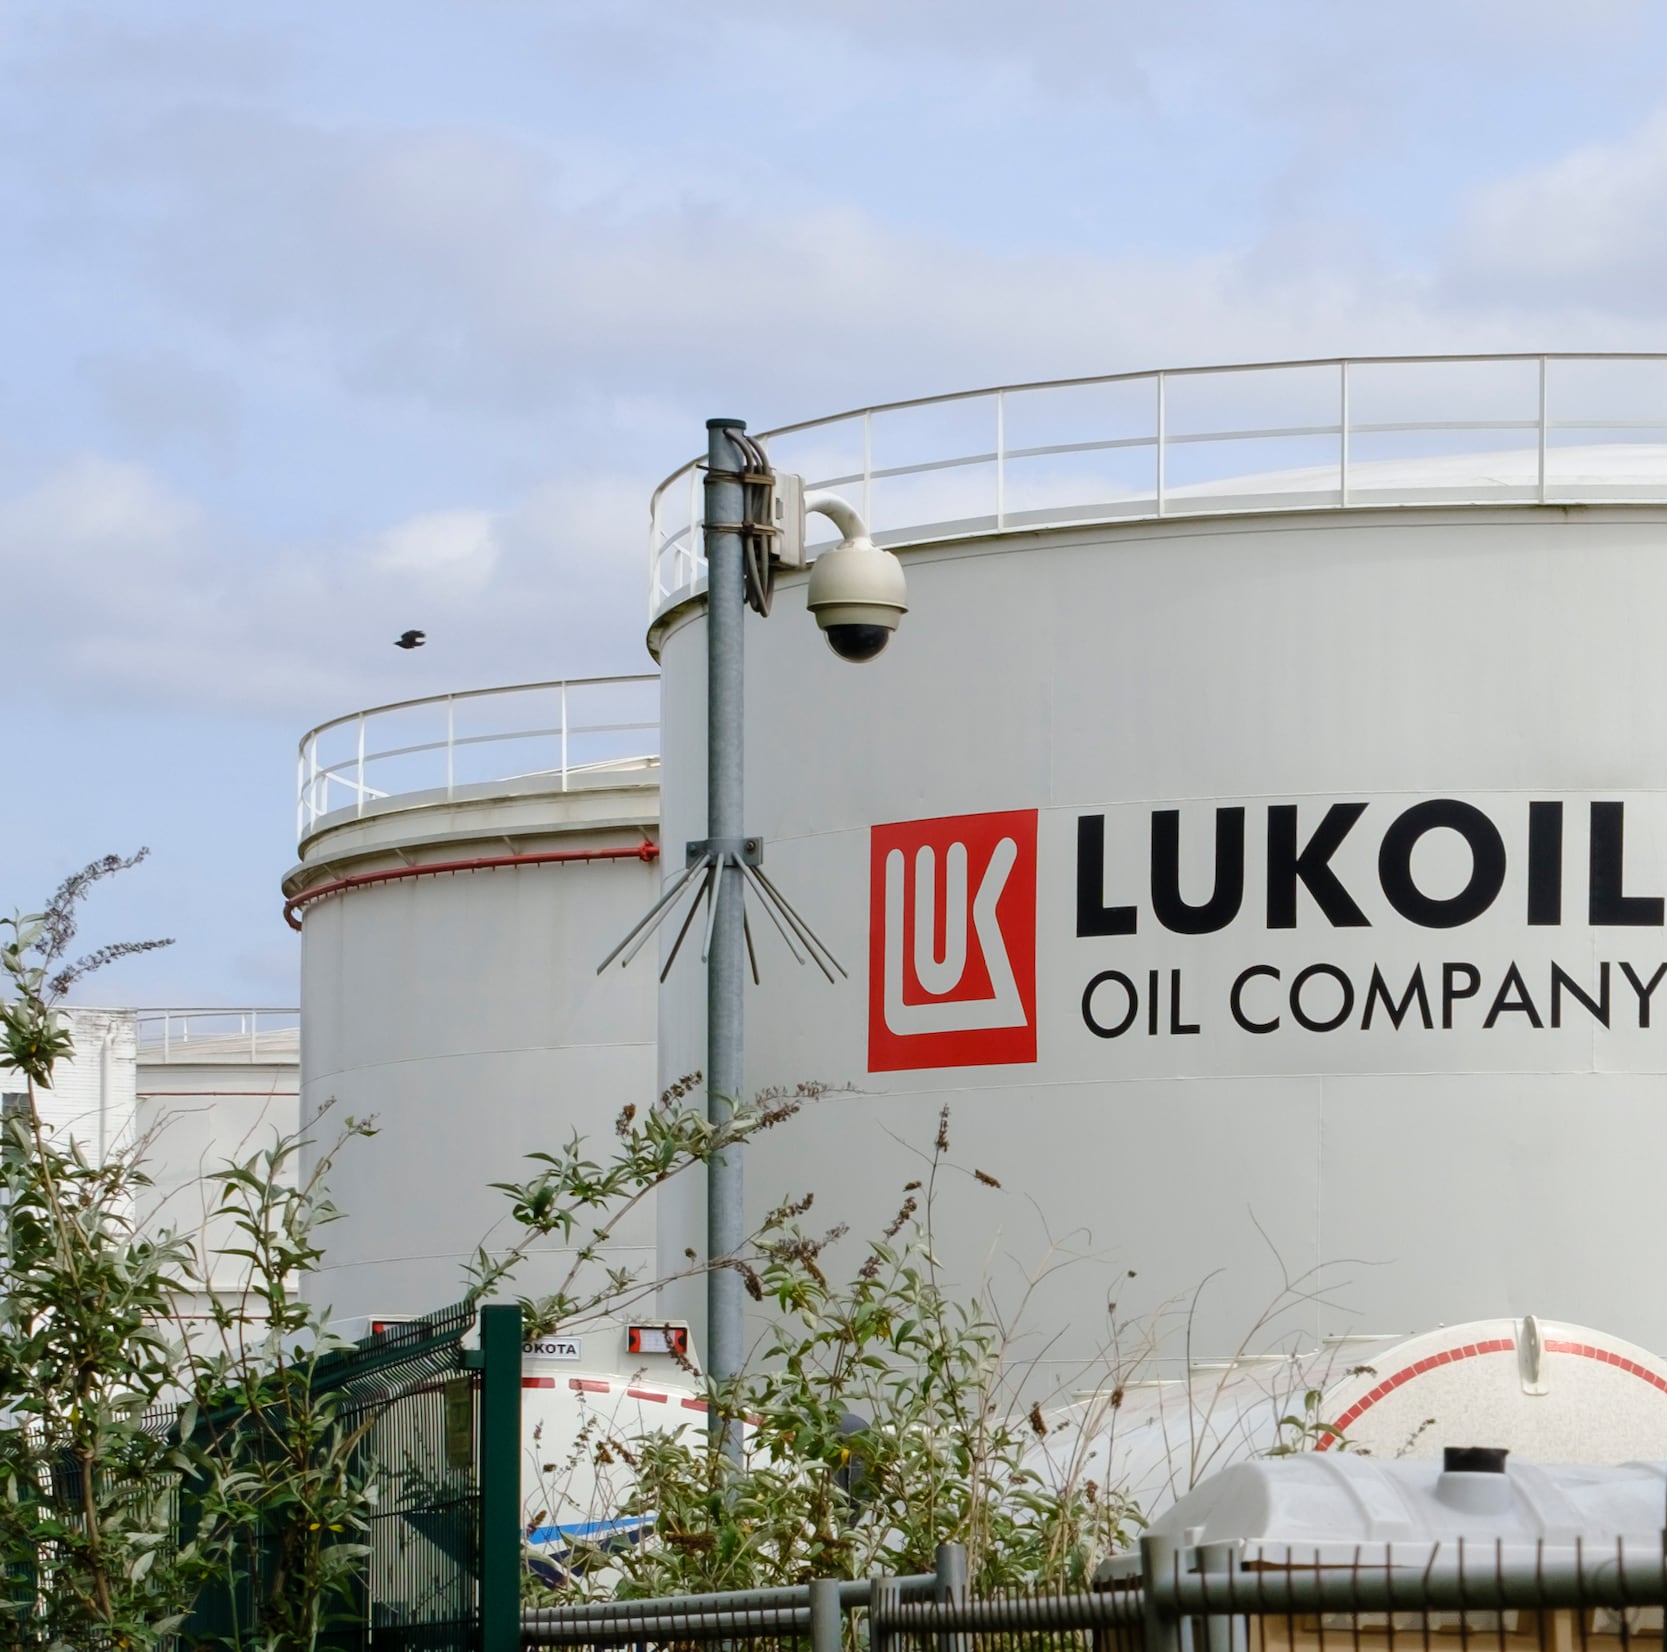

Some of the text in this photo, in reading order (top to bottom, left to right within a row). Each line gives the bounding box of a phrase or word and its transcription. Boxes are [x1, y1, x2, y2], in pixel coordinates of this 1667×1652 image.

[1076, 798, 1667, 938] LUKOIL
[1080, 966, 1202, 1040] OIL
[522, 1343, 577, 1355] OKOTA
